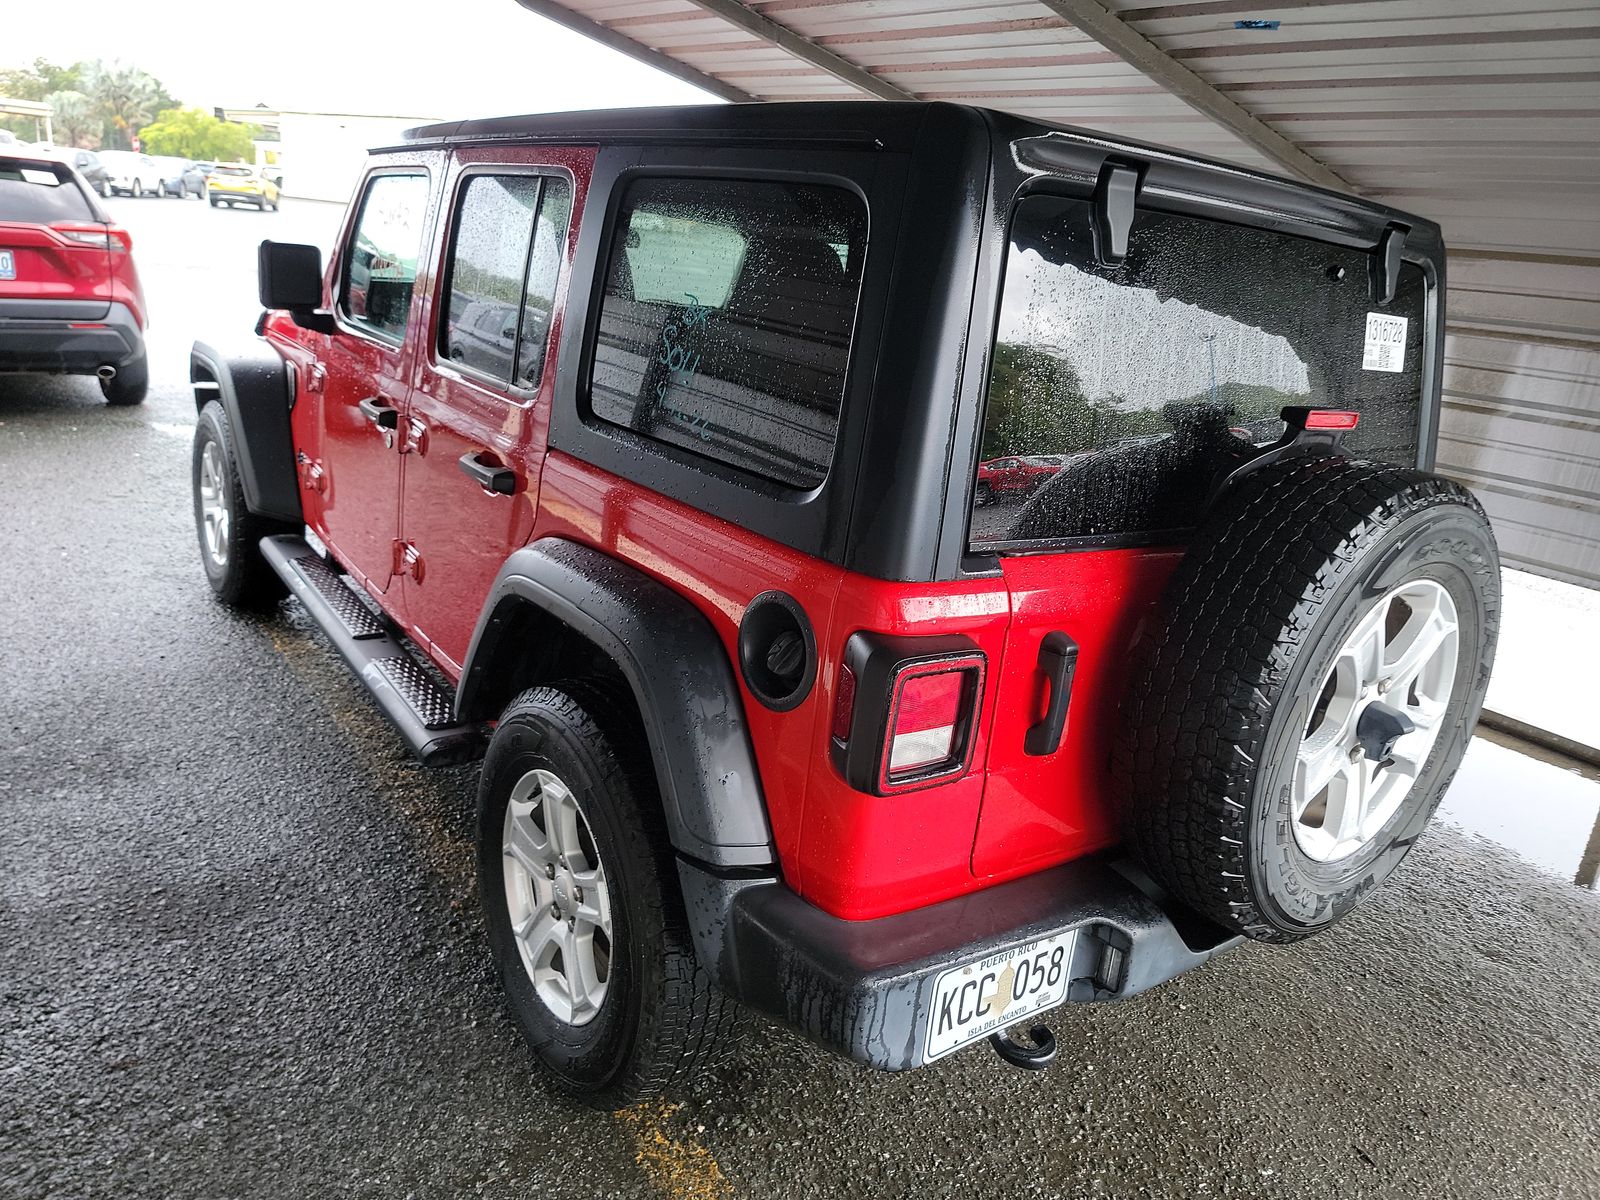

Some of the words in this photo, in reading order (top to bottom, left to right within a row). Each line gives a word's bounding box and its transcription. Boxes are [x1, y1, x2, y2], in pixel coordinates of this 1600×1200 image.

[1368, 319, 1404, 344] 1316728
[979, 949, 1015, 971] PUERTO
[1017, 942, 1038, 957] RICO
[937, 972, 996, 1036] KCC
[1012, 945, 1064, 1001] 058
[967, 1025, 983, 1037] ISLA
[984, 1019, 996, 1031] DEL
[998, 1005, 1027, 1022] ENCANTO
